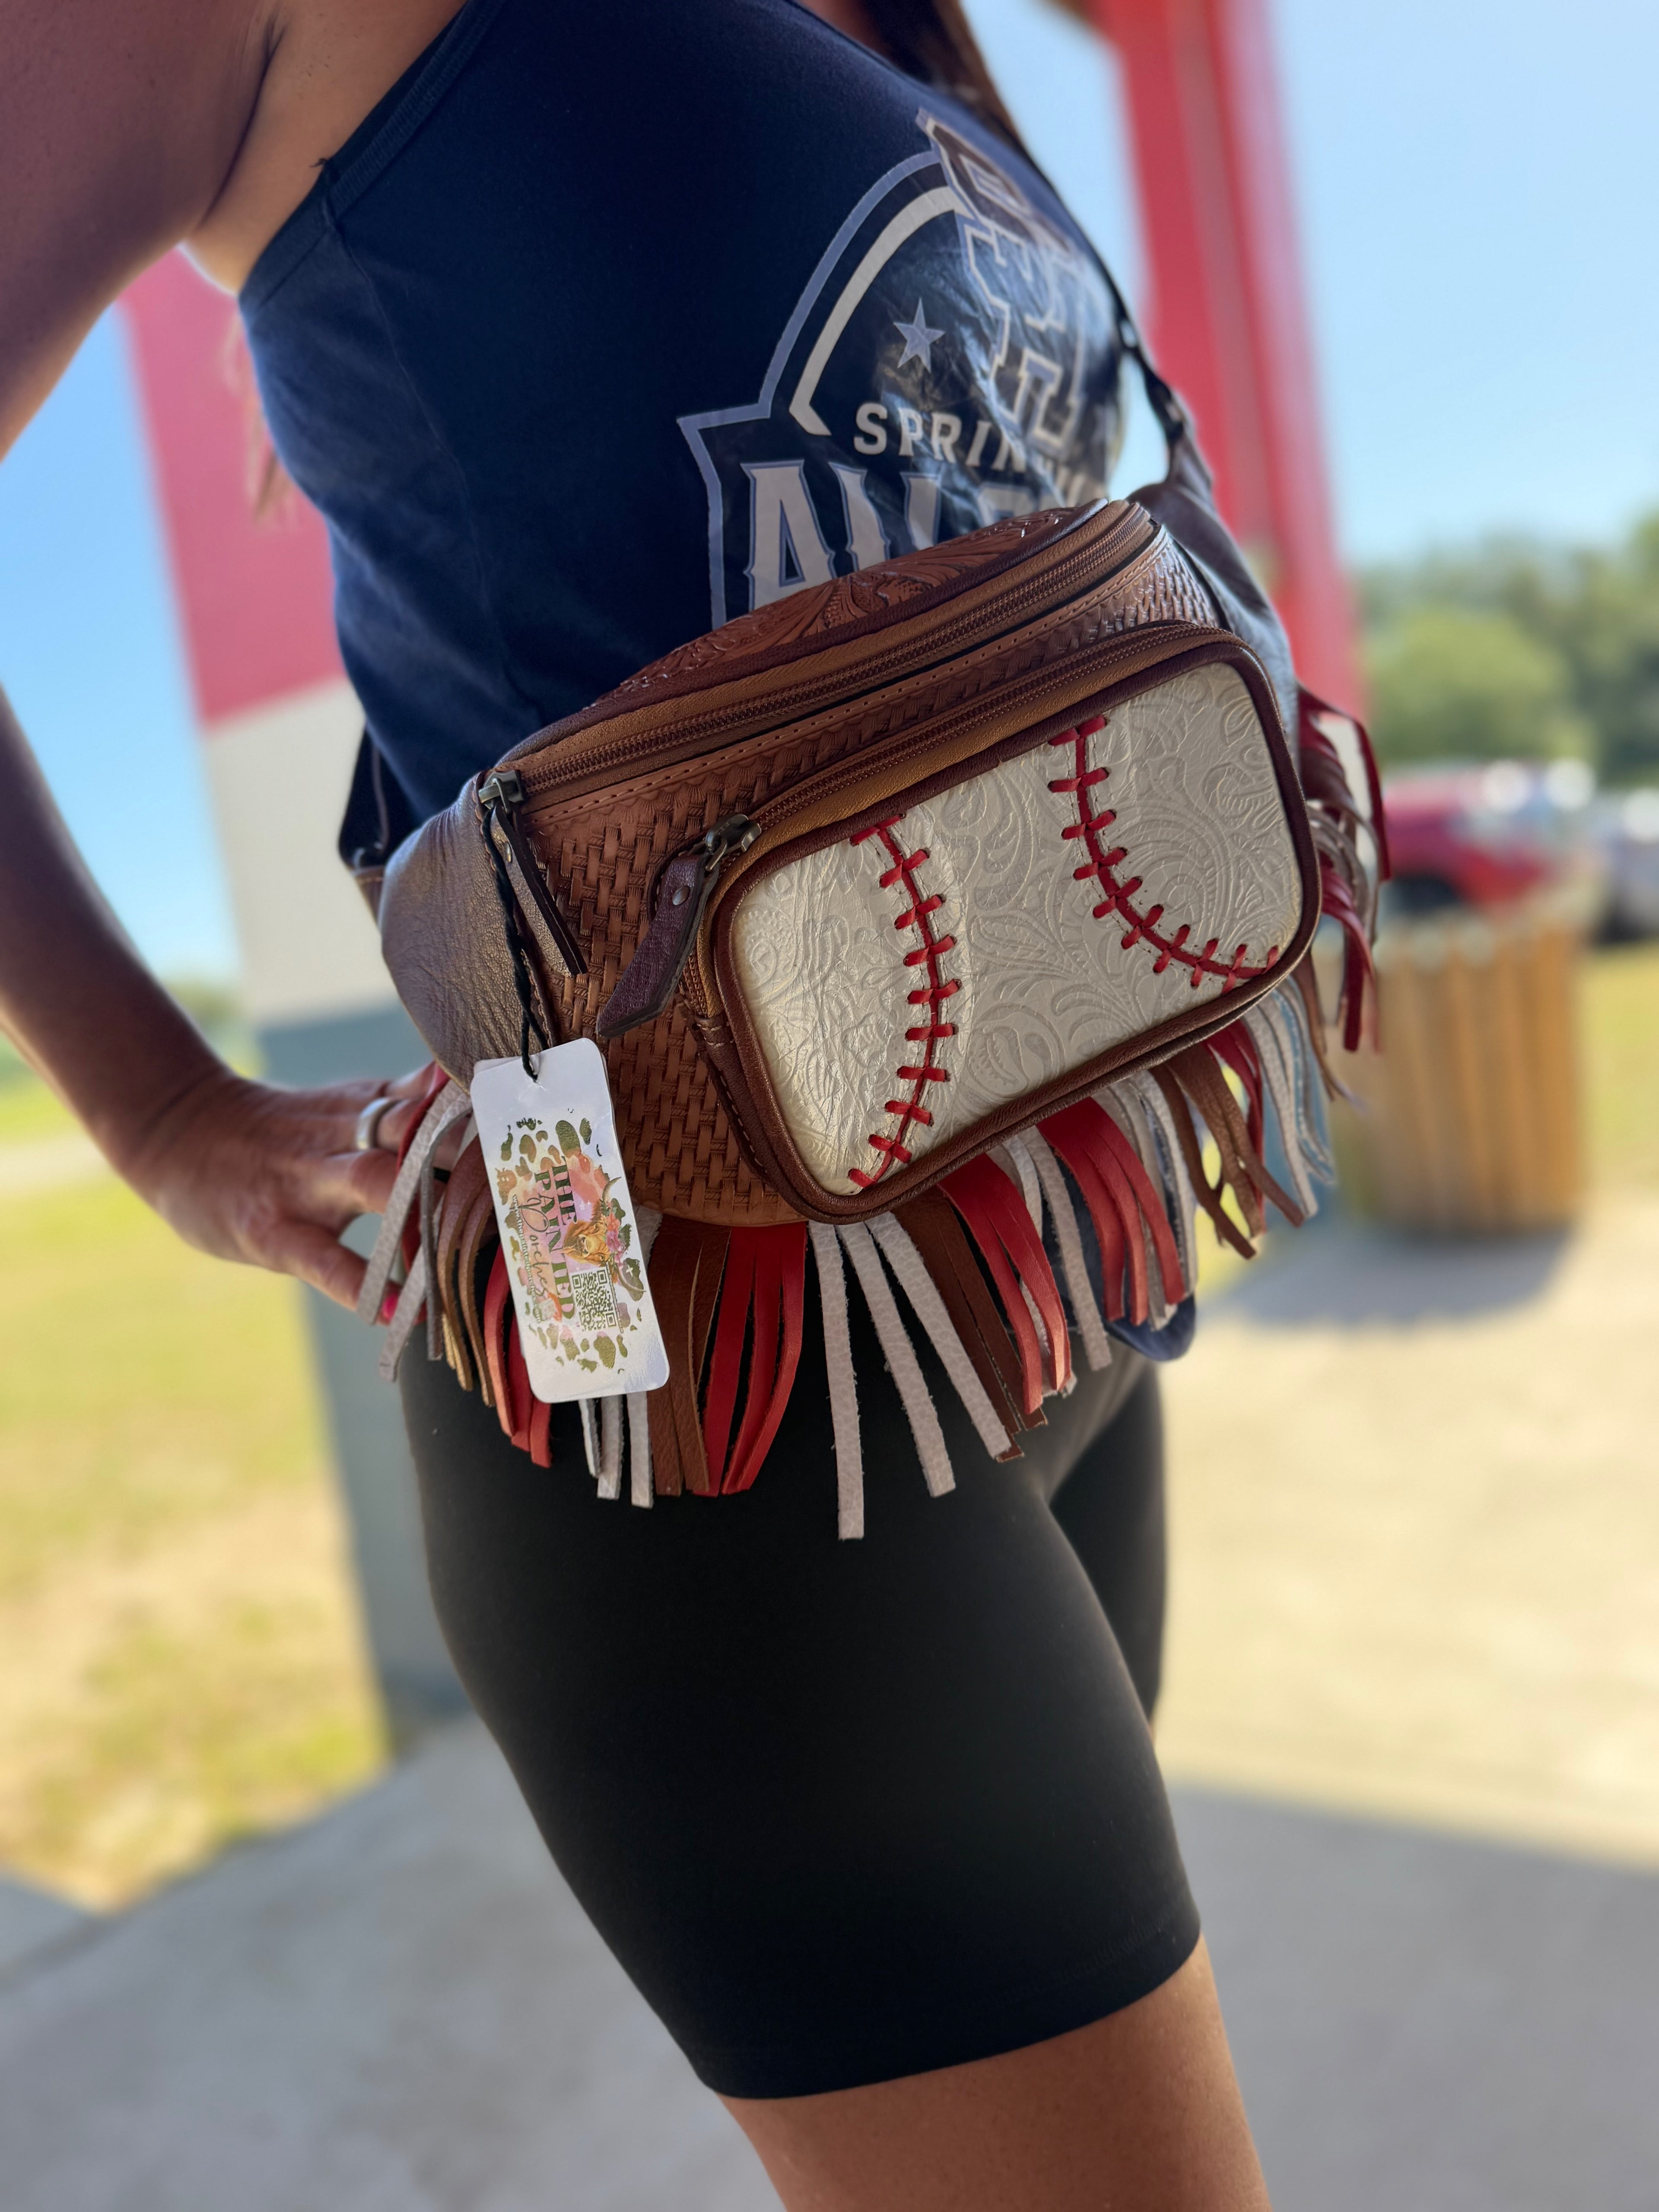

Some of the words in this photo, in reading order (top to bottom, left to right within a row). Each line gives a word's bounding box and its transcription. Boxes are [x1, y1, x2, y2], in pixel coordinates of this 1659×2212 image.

[553, 1156, 578, 1225] THE
[510, 1197, 549, 1296] Porches
[534, 1170, 576, 1319] PAINTED
